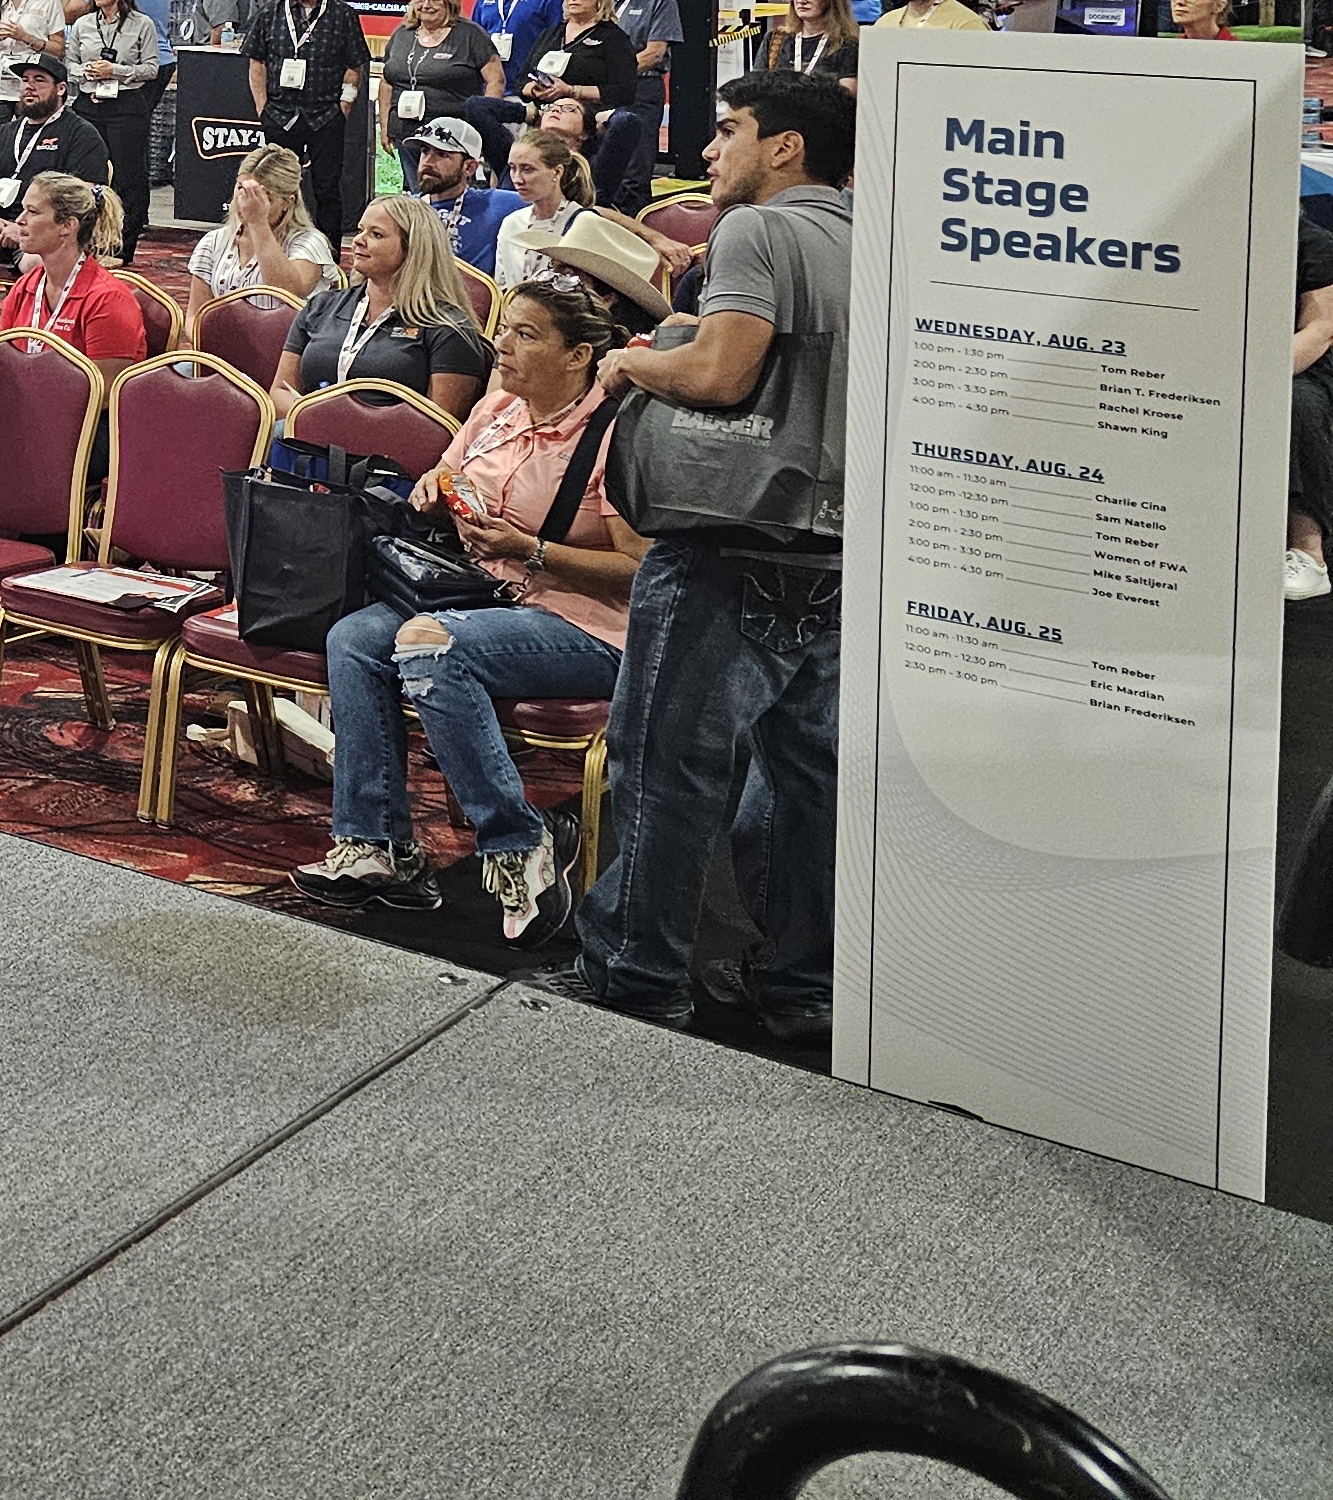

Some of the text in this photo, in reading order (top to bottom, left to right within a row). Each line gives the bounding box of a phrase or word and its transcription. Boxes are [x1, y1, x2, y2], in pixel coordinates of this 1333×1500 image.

[945, 117, 1065, 159] Main
[942, 167, 1089, 218] Stage
[940, 218, 1182, 274] Speakers
[915, 318, 1126, 354] WEDNESDAY, AUG. 23
[914, 341, 1004, 360] 1:00 pm 1:30 pm
[914, 360, 1007, 379] 2:00 pm 2:30 pm
[1101, 365, 1165, 379] Tom Reber
[913, 378, 1007, 397] 3:00 pm 3:30 pm
[1100, 384, 1221, 406] Brian T. Frederiksen
[913, 396, 1009, 416] 4:00 pm 4:30 pm
[1099, 403, 1183, 420] Rachel Kroese
[1098, 421, 1168, 439] Shawn King
[912, 441, 1104, 482] THURSDAY, AUG. 24
[910, 464, 934, 476] 11:00
[963, 473, 987, 484] 11:30
[989, 479, 1006, 487] am
[910, 483, 935, 493] 12:00
[939, 489, 955, 497] pm
[991, 497, 1008, 506] pm
[1096, 494, 1166, 512] Charlie Cina
[1096, 514, 1166, 531] Sam Natello
[1095, 532, 1159, 549] Tom Reber
[1094, 550, 1140, 565] Women
[1160, 562, 1188, 573] FWA
[1093, 569, 1177, 591] Mike Saltijeral
[1092, 588, 1160, 607] Joe Everest
[907, 600, 1062, 641] FRIDAY, AUG. 25
[906, 624, 929, 635] 11:00
[932, 631, 949, 639] am
[982, 640, 998, 650] am
[905, 642, 1006, 670] 12:00 pm 12:30 pm
[905, 660, 997, 686] 2:30 pm 3:00 pm
[1091, 661, 1155, 680] Tom Reber
[1091, 680, 1164, 701] Eric Mardian
[1090, 699, 1195, 726] Brian Frederiksen
